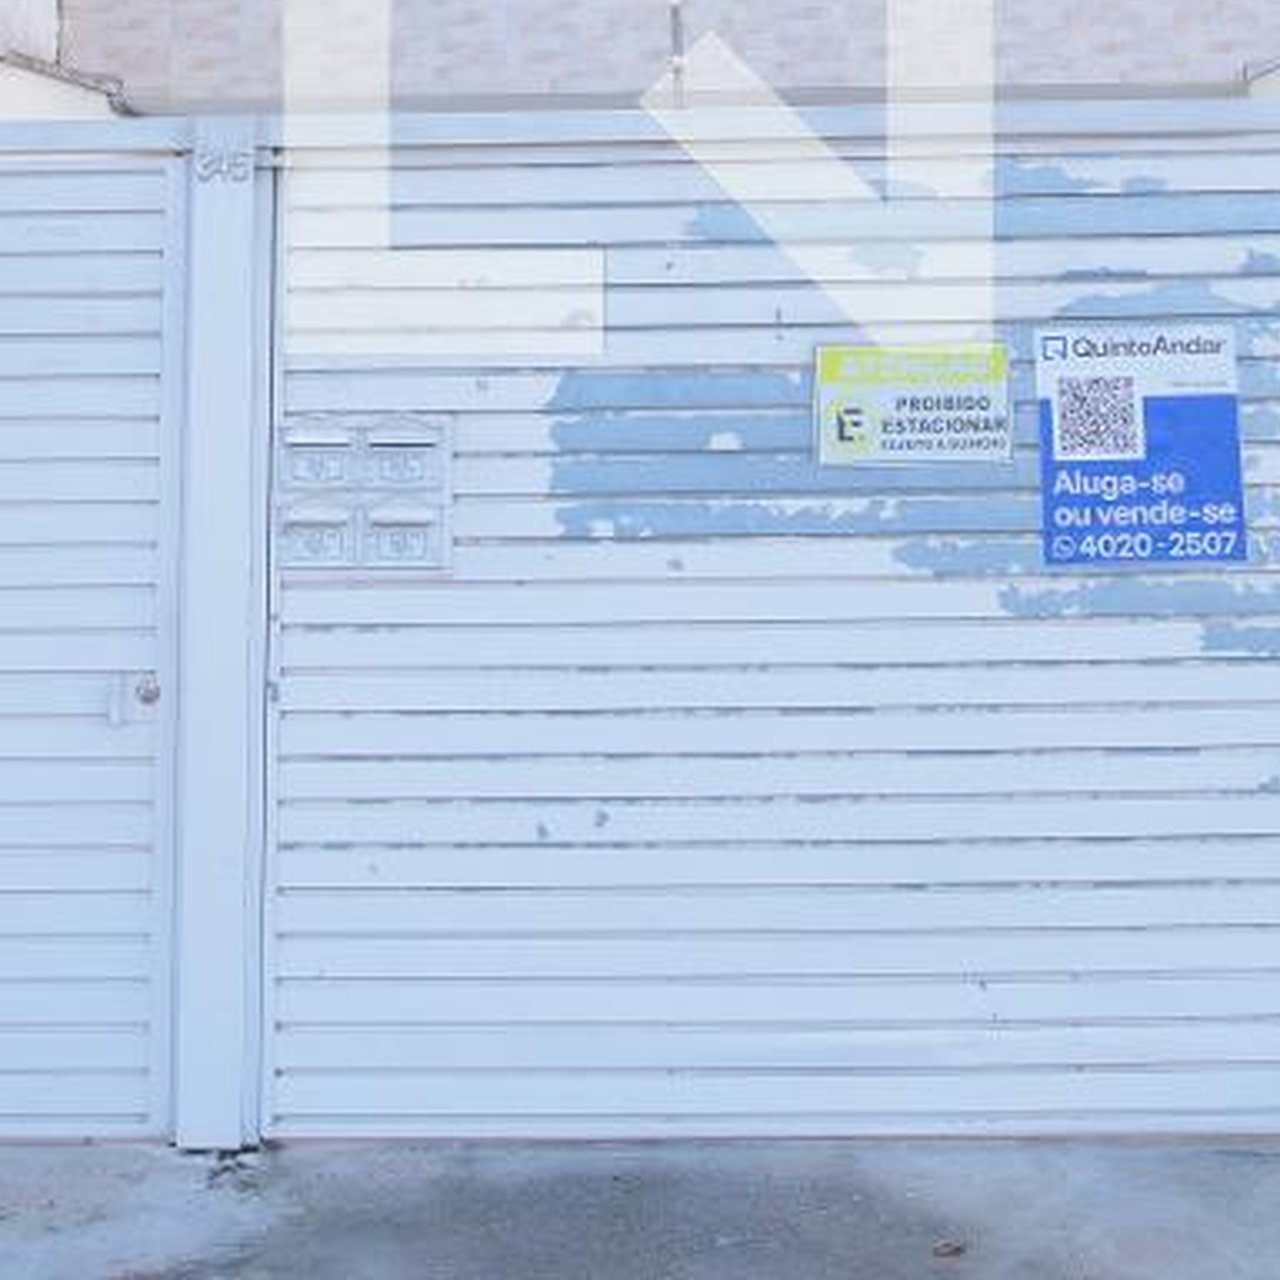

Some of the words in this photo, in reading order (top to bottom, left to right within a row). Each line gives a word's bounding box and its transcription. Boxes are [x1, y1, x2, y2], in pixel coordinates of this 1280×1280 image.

[1071, 334, 1226, 358] QuintoAndar
[895, 394, 991, 412] PROIBIDO
[880, 416, 1008, 435] ESTACIONAR
[1053, 470, 1185, 501] Aluga-se
[1054, 506, 1091, 527] ou
[1096, 500, 1238, 525] vende-se
